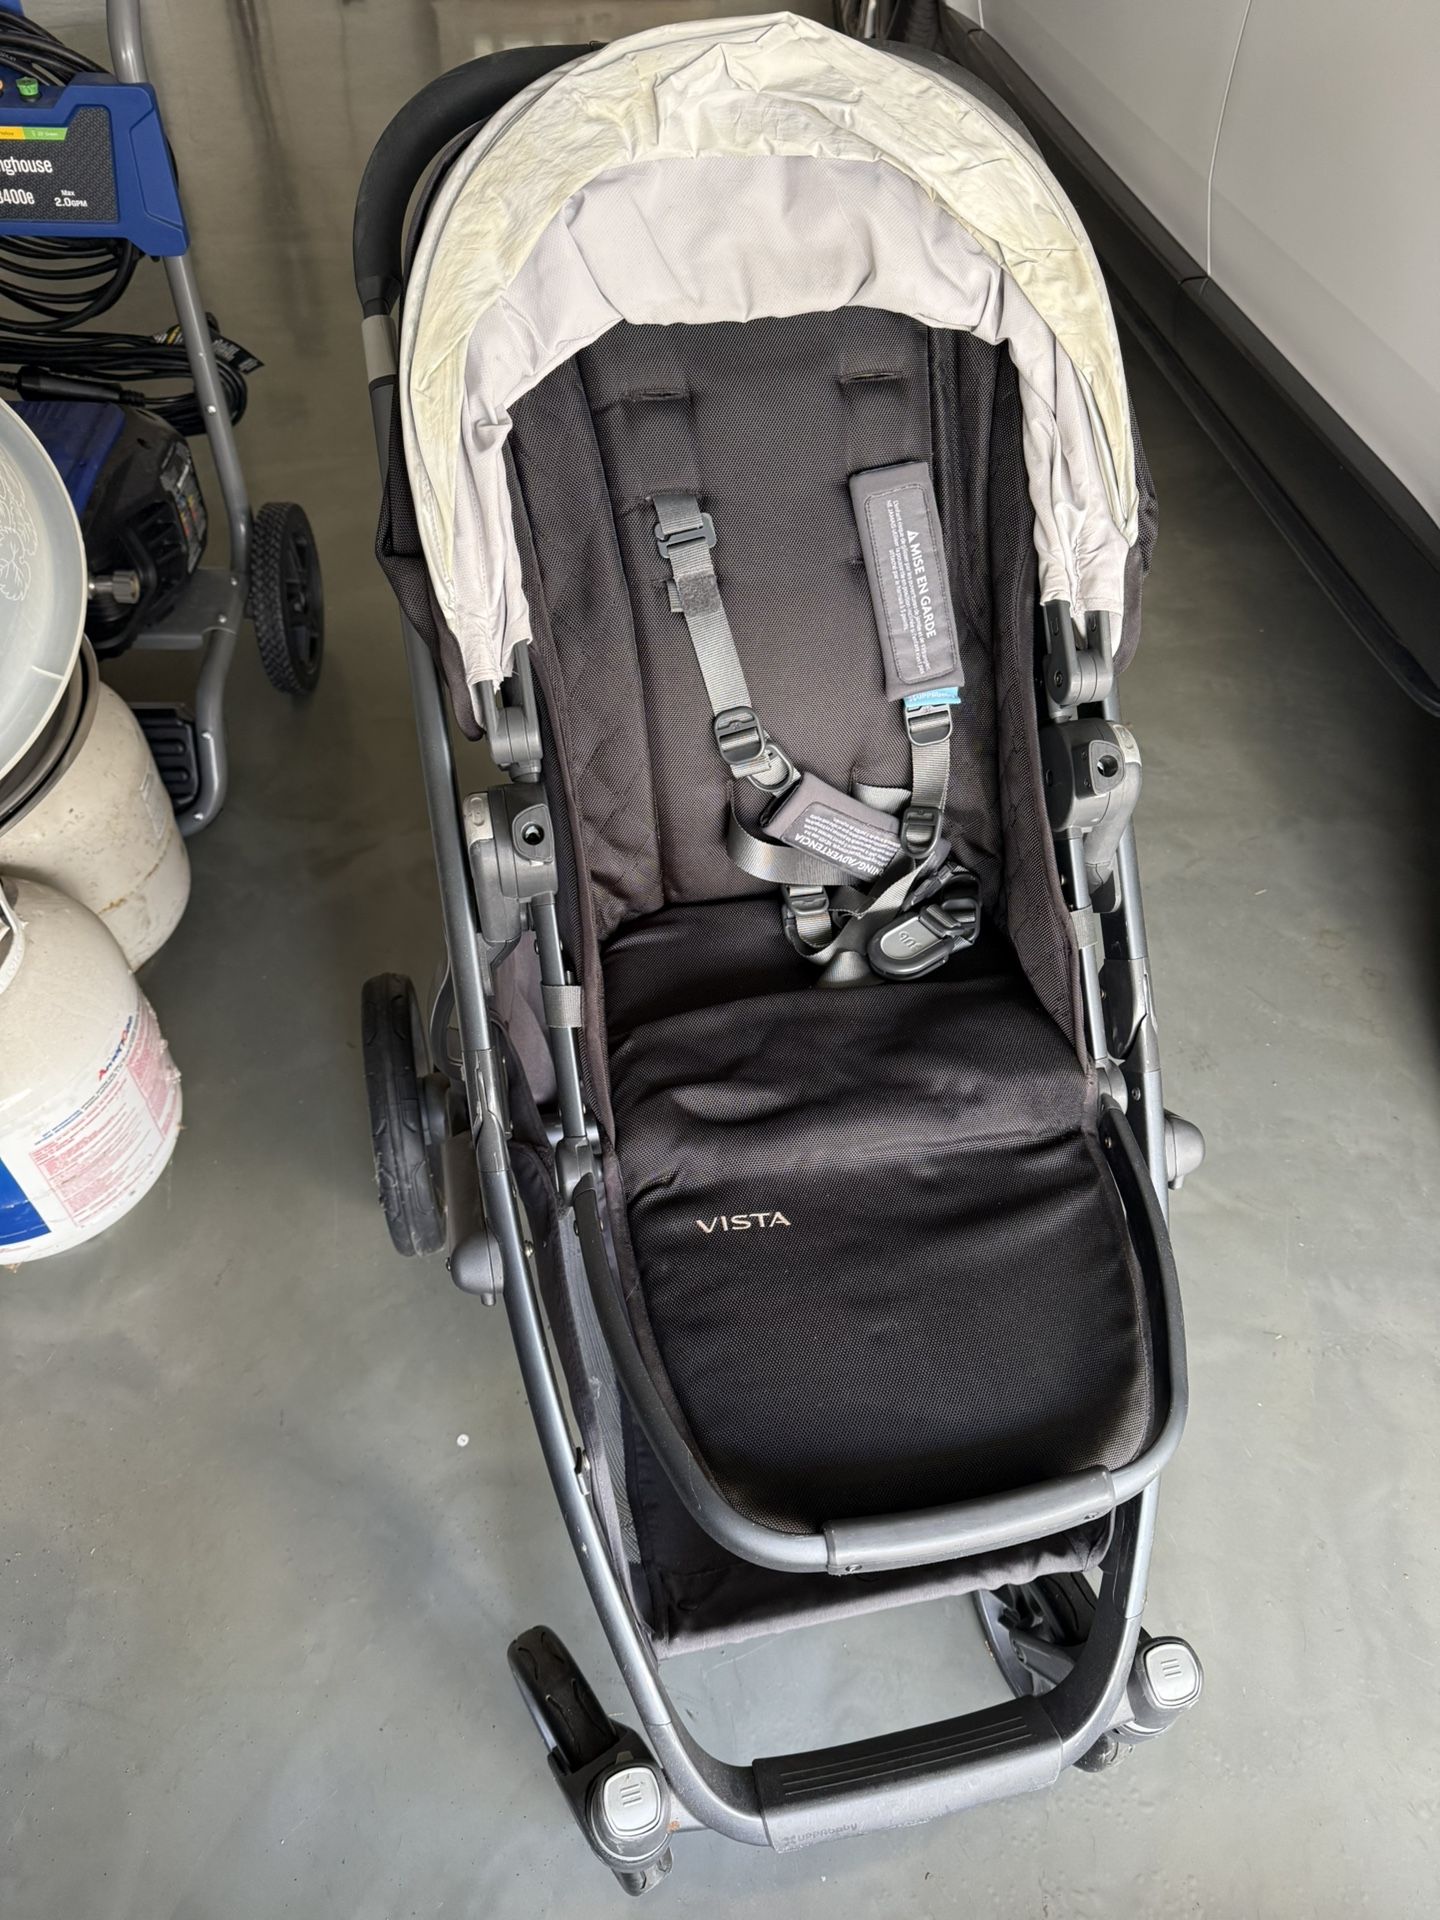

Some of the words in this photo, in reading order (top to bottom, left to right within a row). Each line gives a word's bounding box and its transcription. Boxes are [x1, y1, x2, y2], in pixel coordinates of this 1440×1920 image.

[909, 542, 925, 575] MISE
[915, 575, 928, 594] EN
[919, 595, 937, 638] GARDE
[795, 833, 883, 876] NING/ADVERTENCIA
[696, 1211, 792, 1234] VISTA
